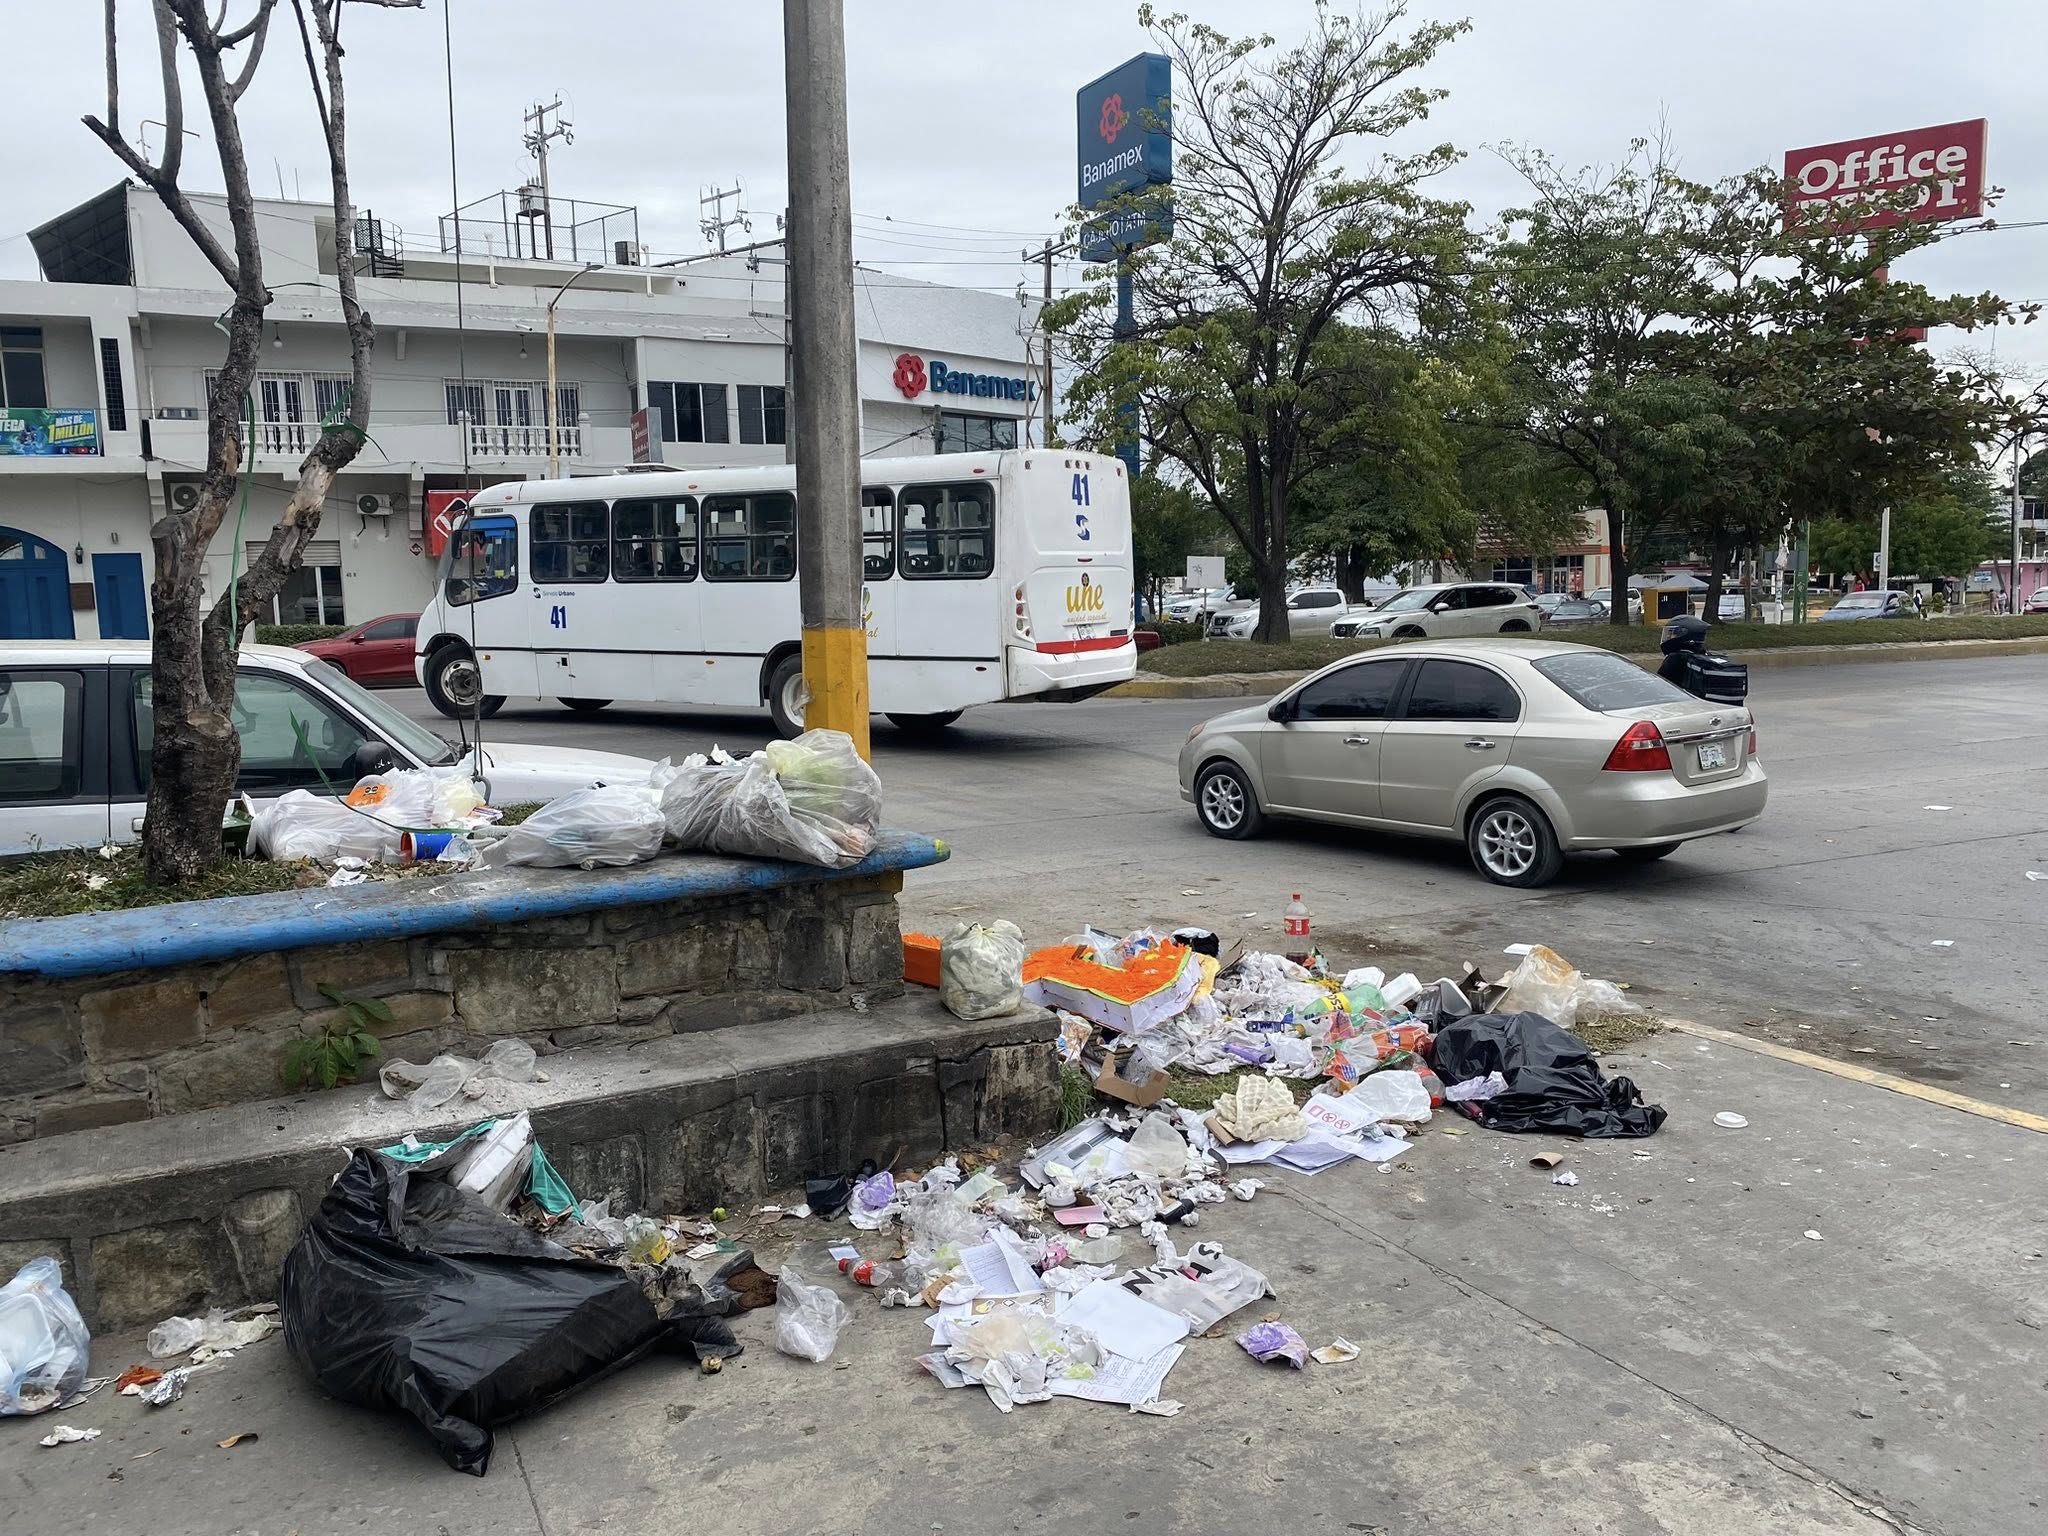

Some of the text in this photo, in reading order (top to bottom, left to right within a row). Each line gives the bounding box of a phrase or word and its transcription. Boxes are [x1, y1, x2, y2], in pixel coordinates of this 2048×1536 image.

[1083, 144, 1143, 187] Banamex
[1798, 144, 1968, 195] Office
[930, 361, 1036, 402] Banamex
[1072, 474, 1090, 506] 41
[551, 606, 566, 628] 41
